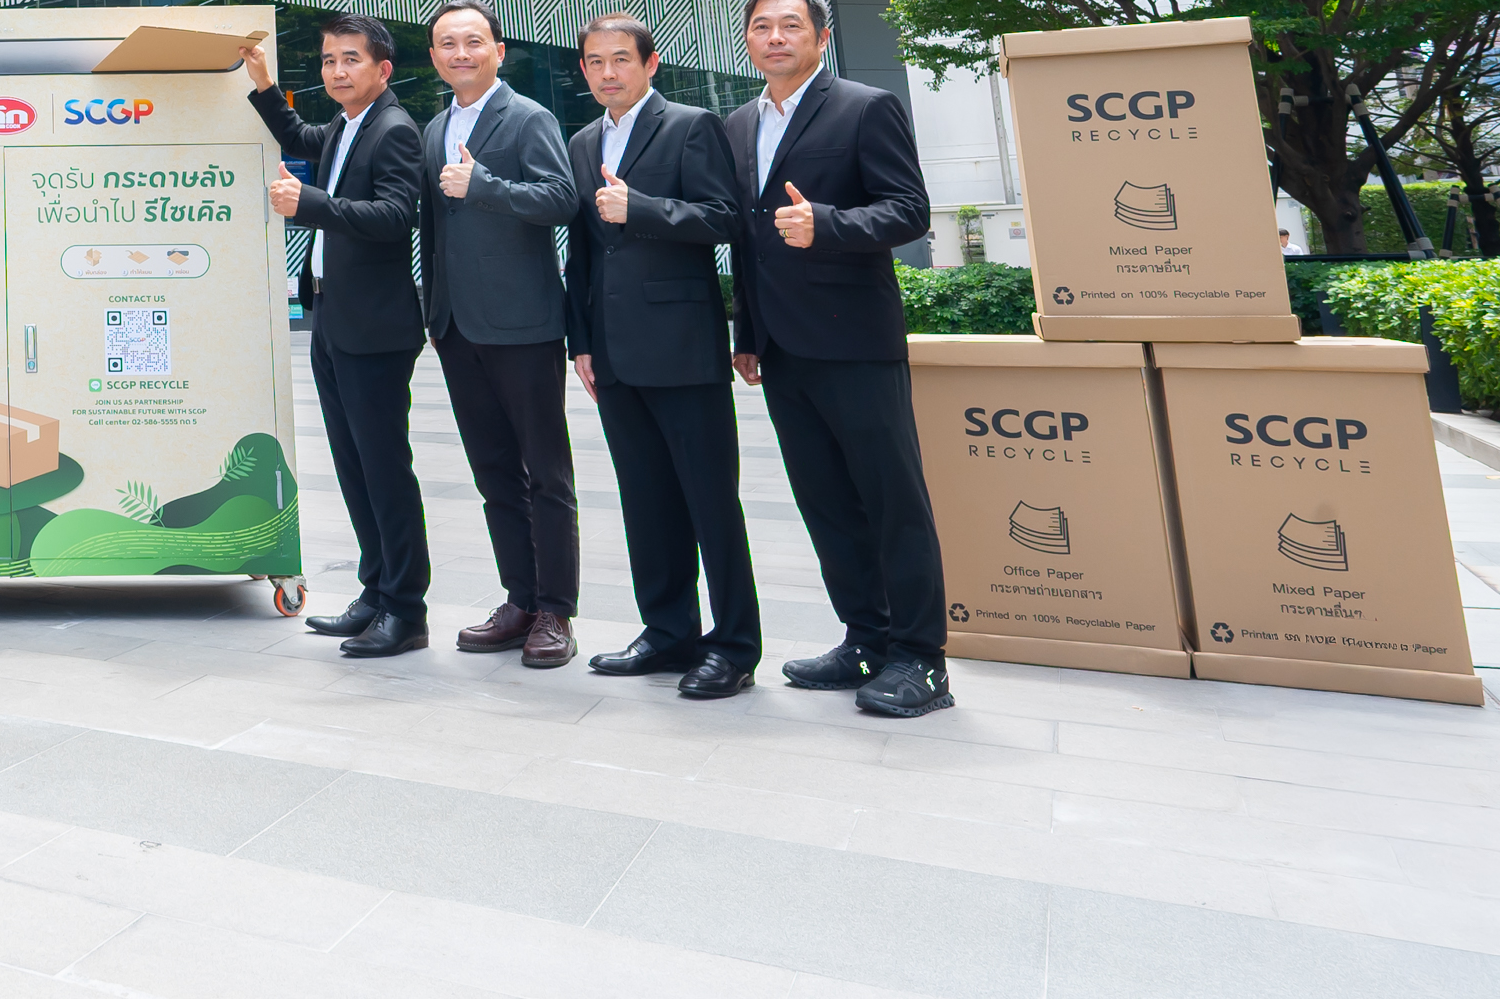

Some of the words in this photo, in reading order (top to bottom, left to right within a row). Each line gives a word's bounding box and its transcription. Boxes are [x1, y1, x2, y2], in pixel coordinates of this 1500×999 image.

[64, 98, 154, 125] SCGP
[1066, 90, 1196, 122] SCGP
[1071, 127, 1198, 142] RECYCLE
[31, 167, 94, 197] จุดรับ
[103, 164, 235, 188] กระดาษลัง
[37, 194, 135, 223] เพื่อนำไป
[144, 197, 232, 222] รีไซเคิล
[1109, 246, 1147, 256] Mixed
[1154, 246, 1193, 257] Paper
[1116, 259, 1191, 275] กระดาษอื่นๆ
[108, 295, 151, 303] CONTACT
[153, 295, 166, 303] US
[1080, 290, 1116, 299] Printed
[1139, 290, 1168, 299] 100%
[1174, 290, 1230, 300] Recyclable
[1235, 289, 1267, 300] Paper
[106, 380, 136, 390] SCGP
[139, 380, 189, 389] RECYCLE
[964, 407, 1089, 441] SCGP
[1225, 413, 1368, 450] SCGP
[968, 444, 1091, 463] RECYCLE
[1230, 453, 1371, 474] RECYCLE
[1003, 565, 1041, 578] Office
[1046, 568, 1084, 580] Paper
[990, 582, 1103, 600] กระดาษถ่ายเอกสาร
[1272, 583, 1315, 596] Mixed
[1323, 586, 1366, 600] Paper
[975, 609, 1010, 620] Printed
[1014, 613, 1027, 621] on
[1033, 614, 1060, 625] 100%
[1066, 616, 1121, 629] Recyclable
[1125, 621, 1156, 632] Paper
